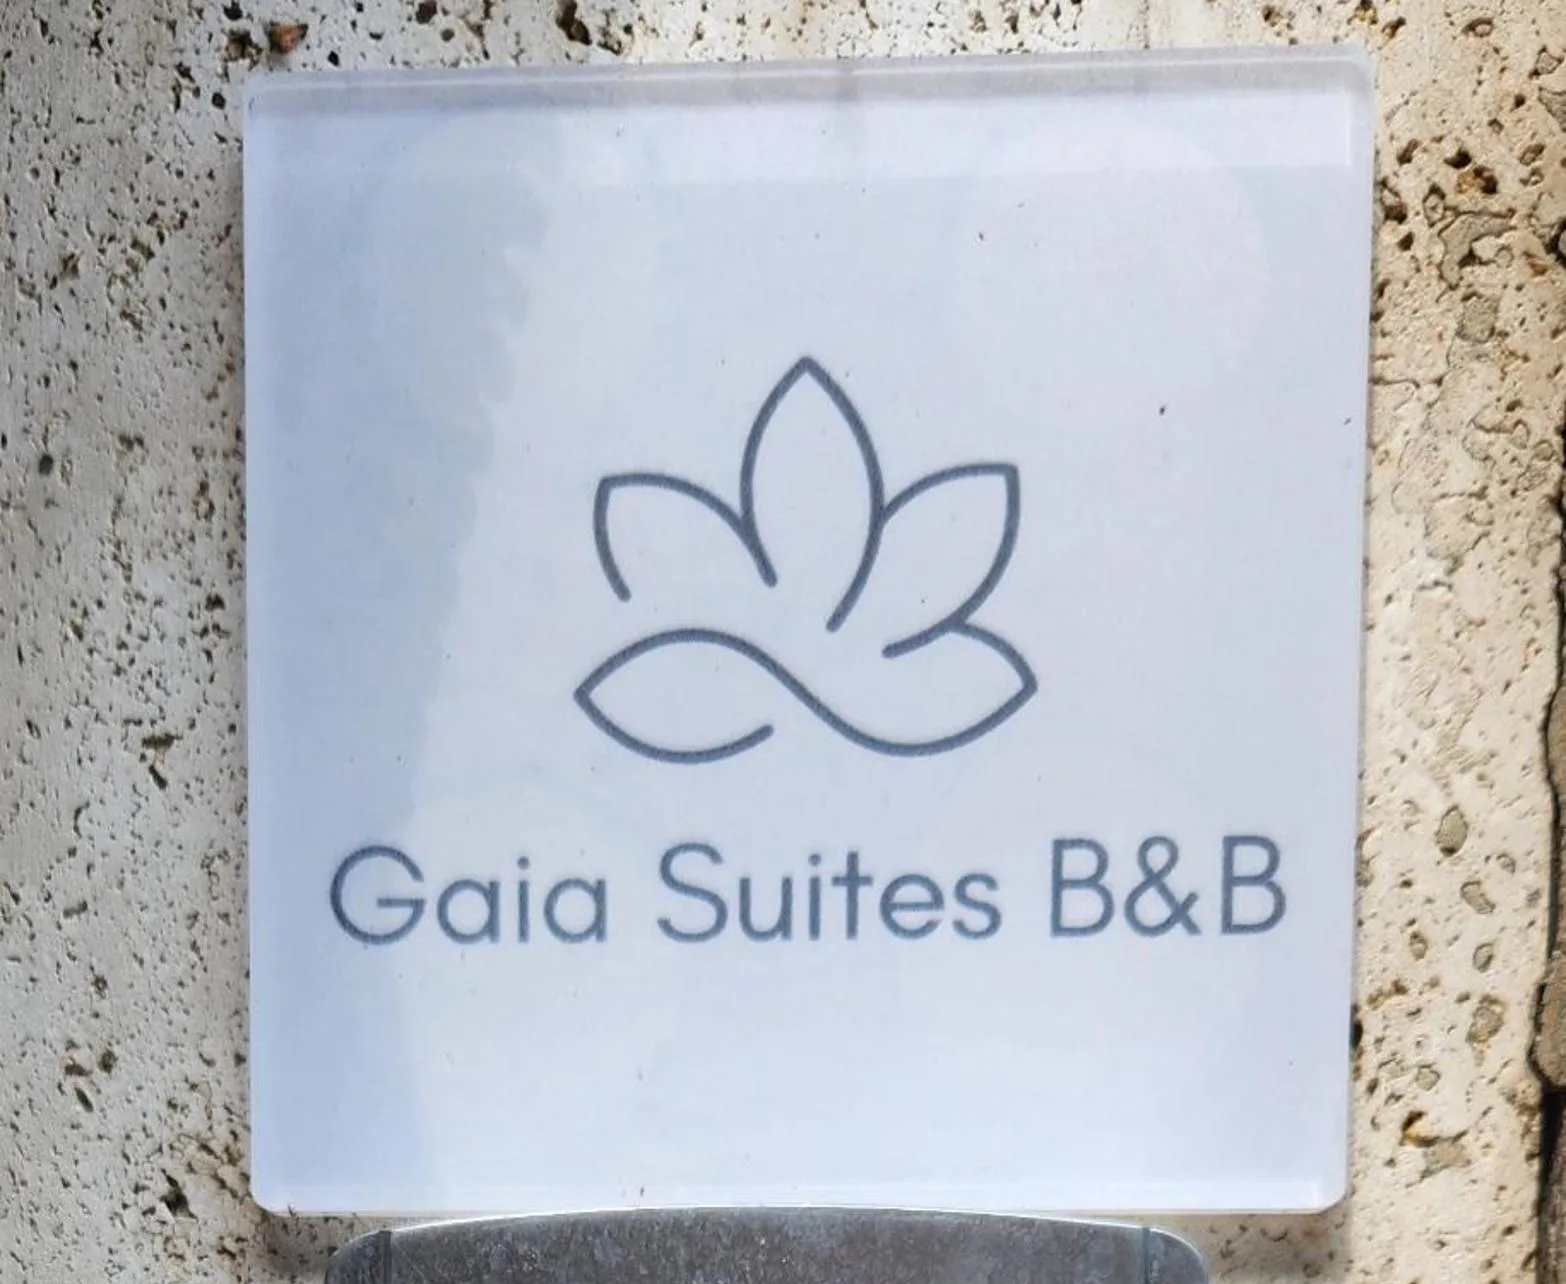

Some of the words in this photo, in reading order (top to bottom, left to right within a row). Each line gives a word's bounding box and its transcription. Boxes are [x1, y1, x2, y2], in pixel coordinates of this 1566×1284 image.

[329, 844, 609, 945] Gaia
[656, 842, 1002, 942] Suites
[1049, 834, 1288, 937] B&B
